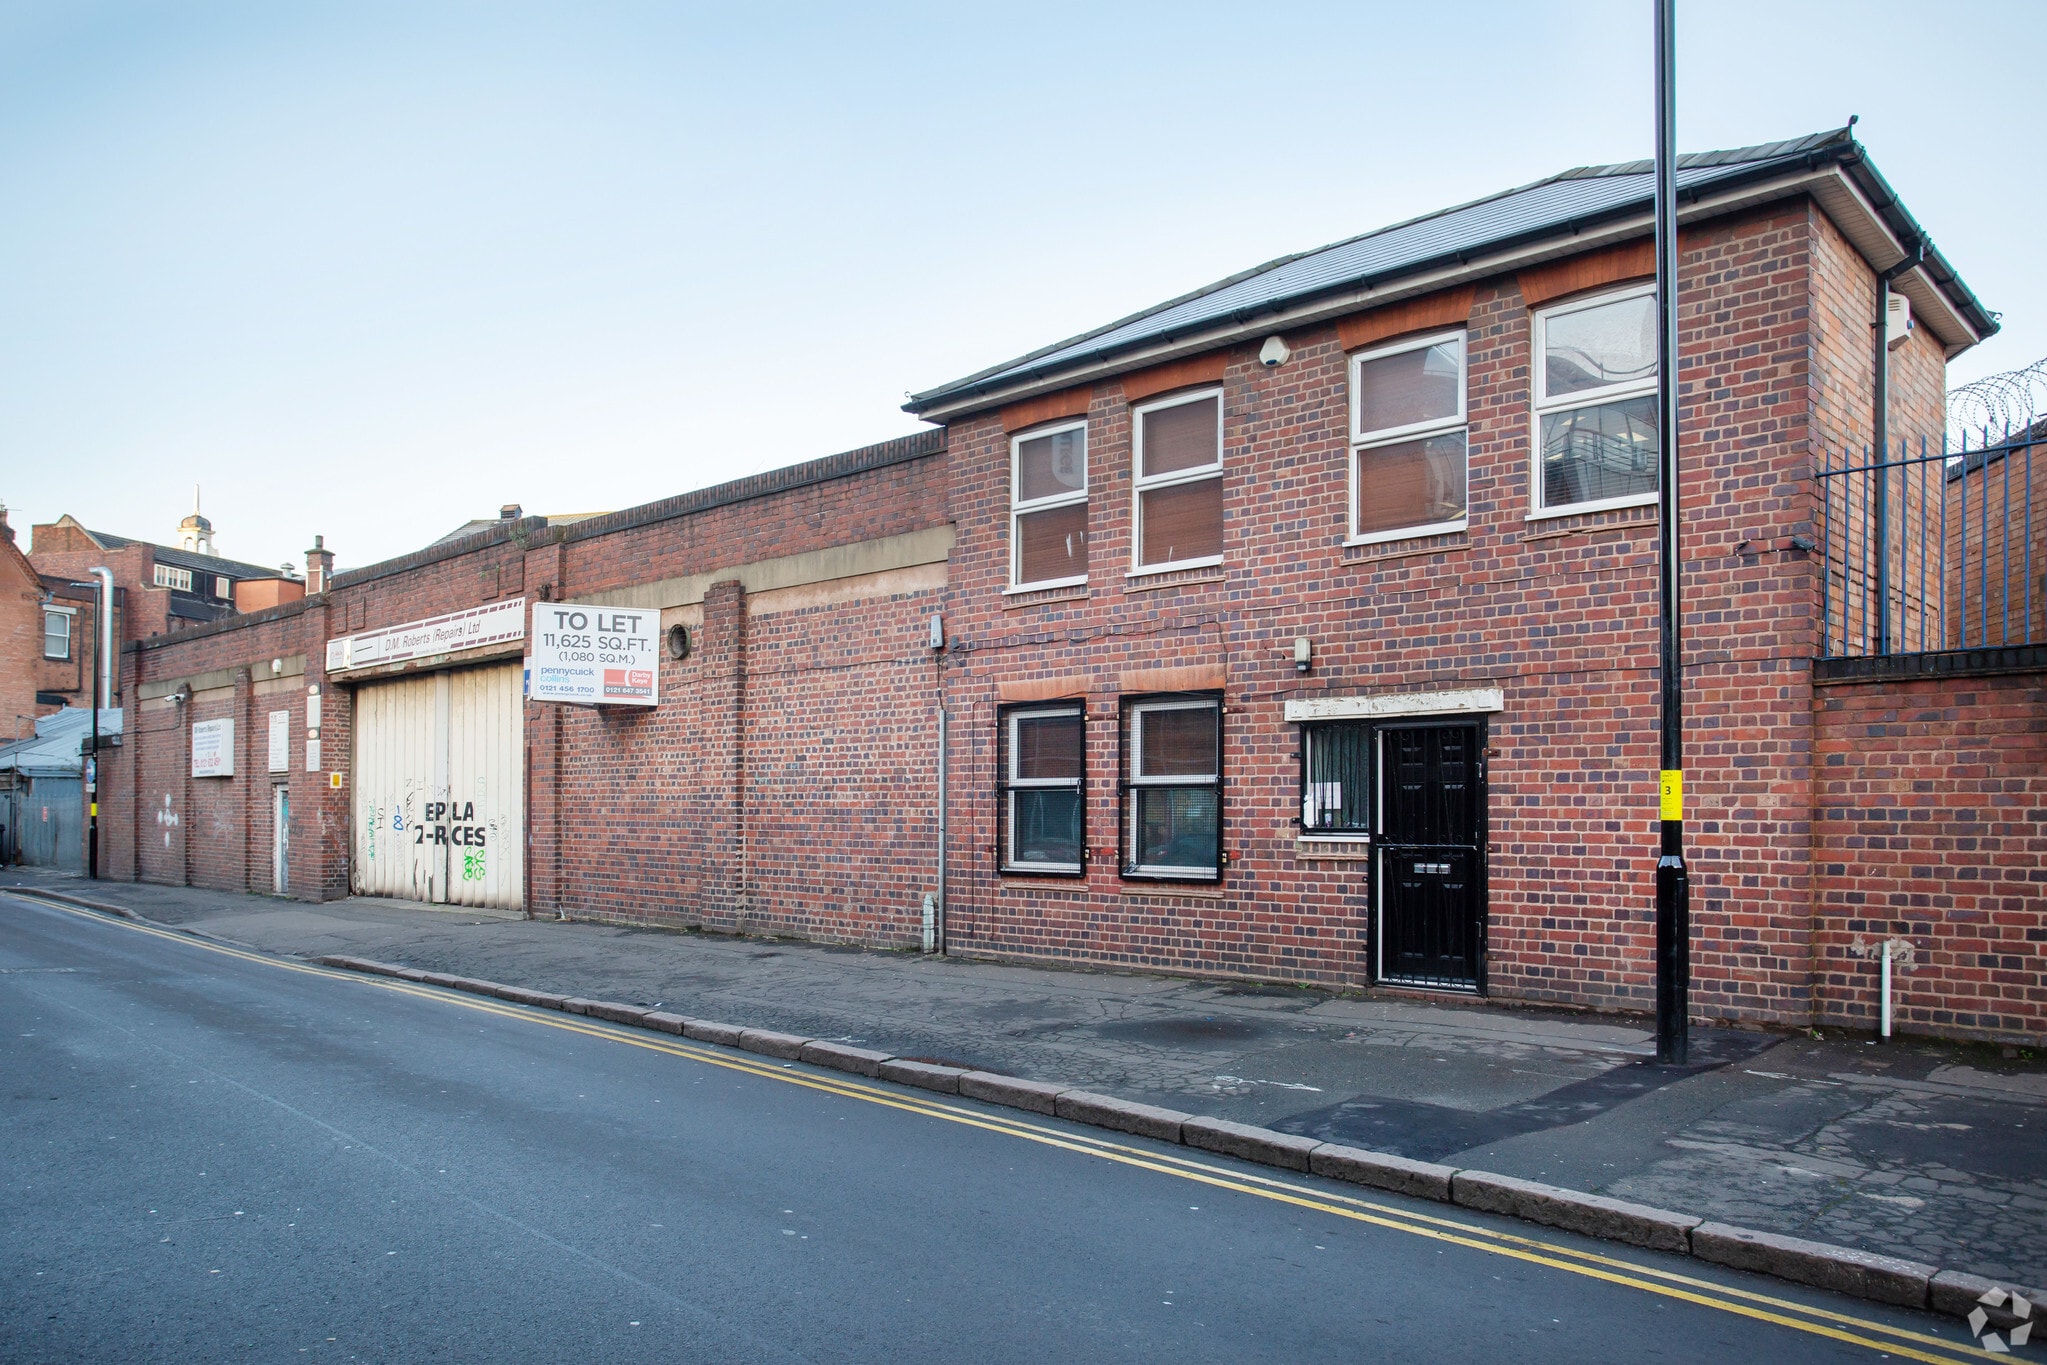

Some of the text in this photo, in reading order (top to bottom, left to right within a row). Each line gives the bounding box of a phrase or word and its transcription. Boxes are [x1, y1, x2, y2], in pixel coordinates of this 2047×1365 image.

[554, 611, 642, 634] TO LET
[403, 633, 430, 648] Roberts
[432, 622, 467, 644] (Repairs)
[468, 620, 481, 634] Ltd
[543, 633, 651, 652] 11,625 SQ.FT.
[558, 651, 636, 665] (1,080 SQ.M.)
[540, 667, 595, 677] pennycuick
[540, 674, 570, 683] collins
[1665, 785, 1672, 795] 3
